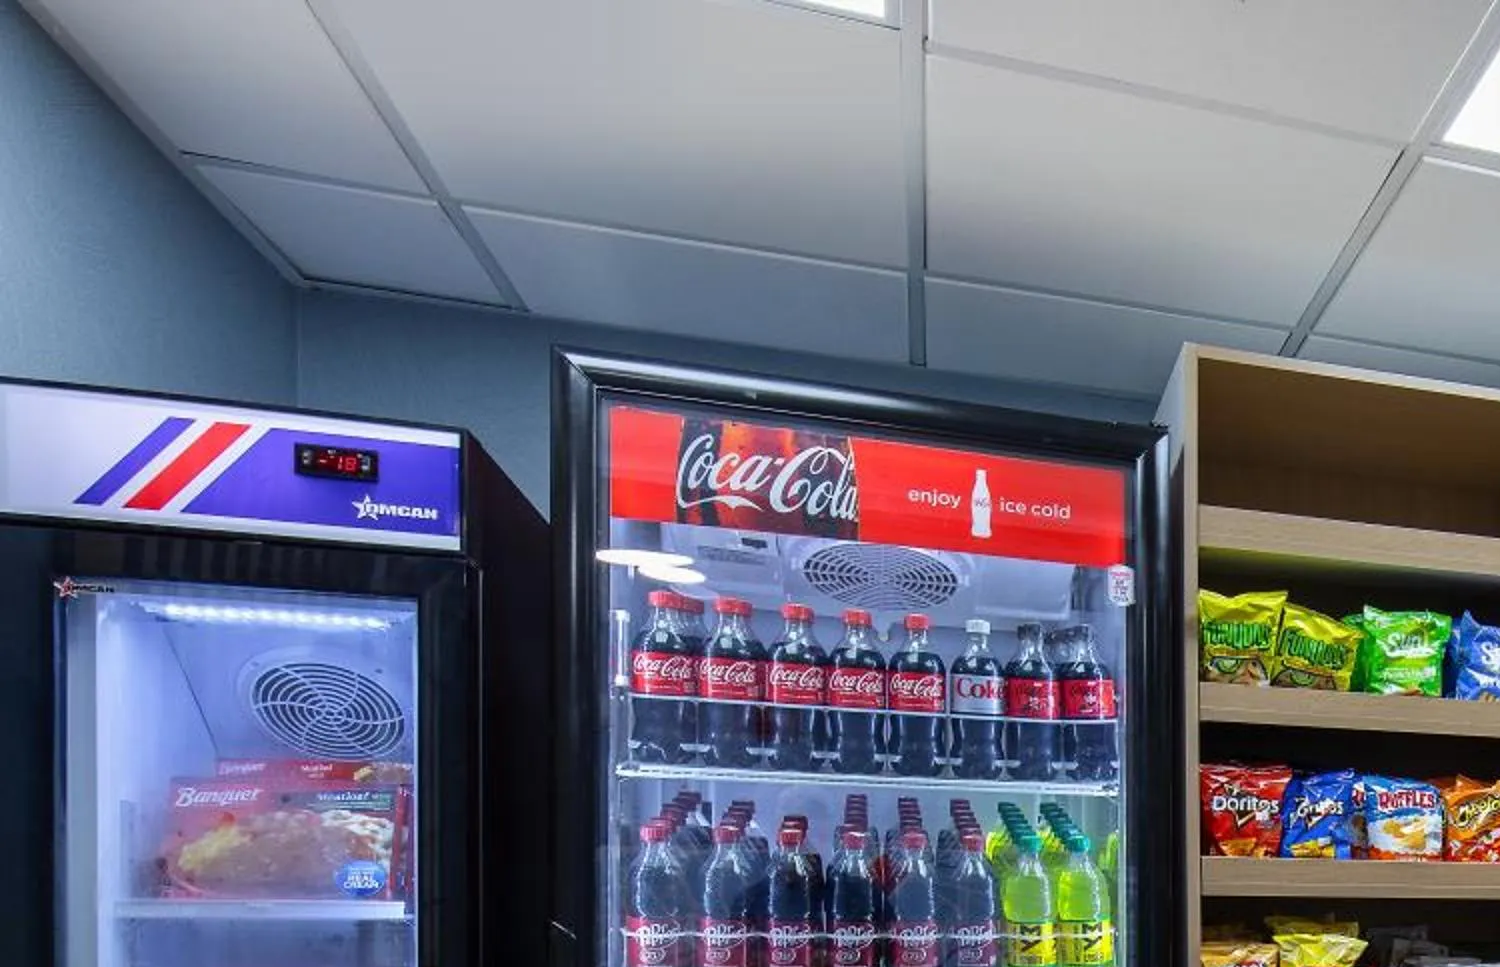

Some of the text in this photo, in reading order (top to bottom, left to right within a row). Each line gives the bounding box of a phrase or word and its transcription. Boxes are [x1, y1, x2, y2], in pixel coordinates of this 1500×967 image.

[675, 433, 858, 514] Coca-Cola
[907, 488, 961, 508] enjoy
[1000, 497, 1071, 519] ice cold
[1212, 794, 1280, 816] Doritos
